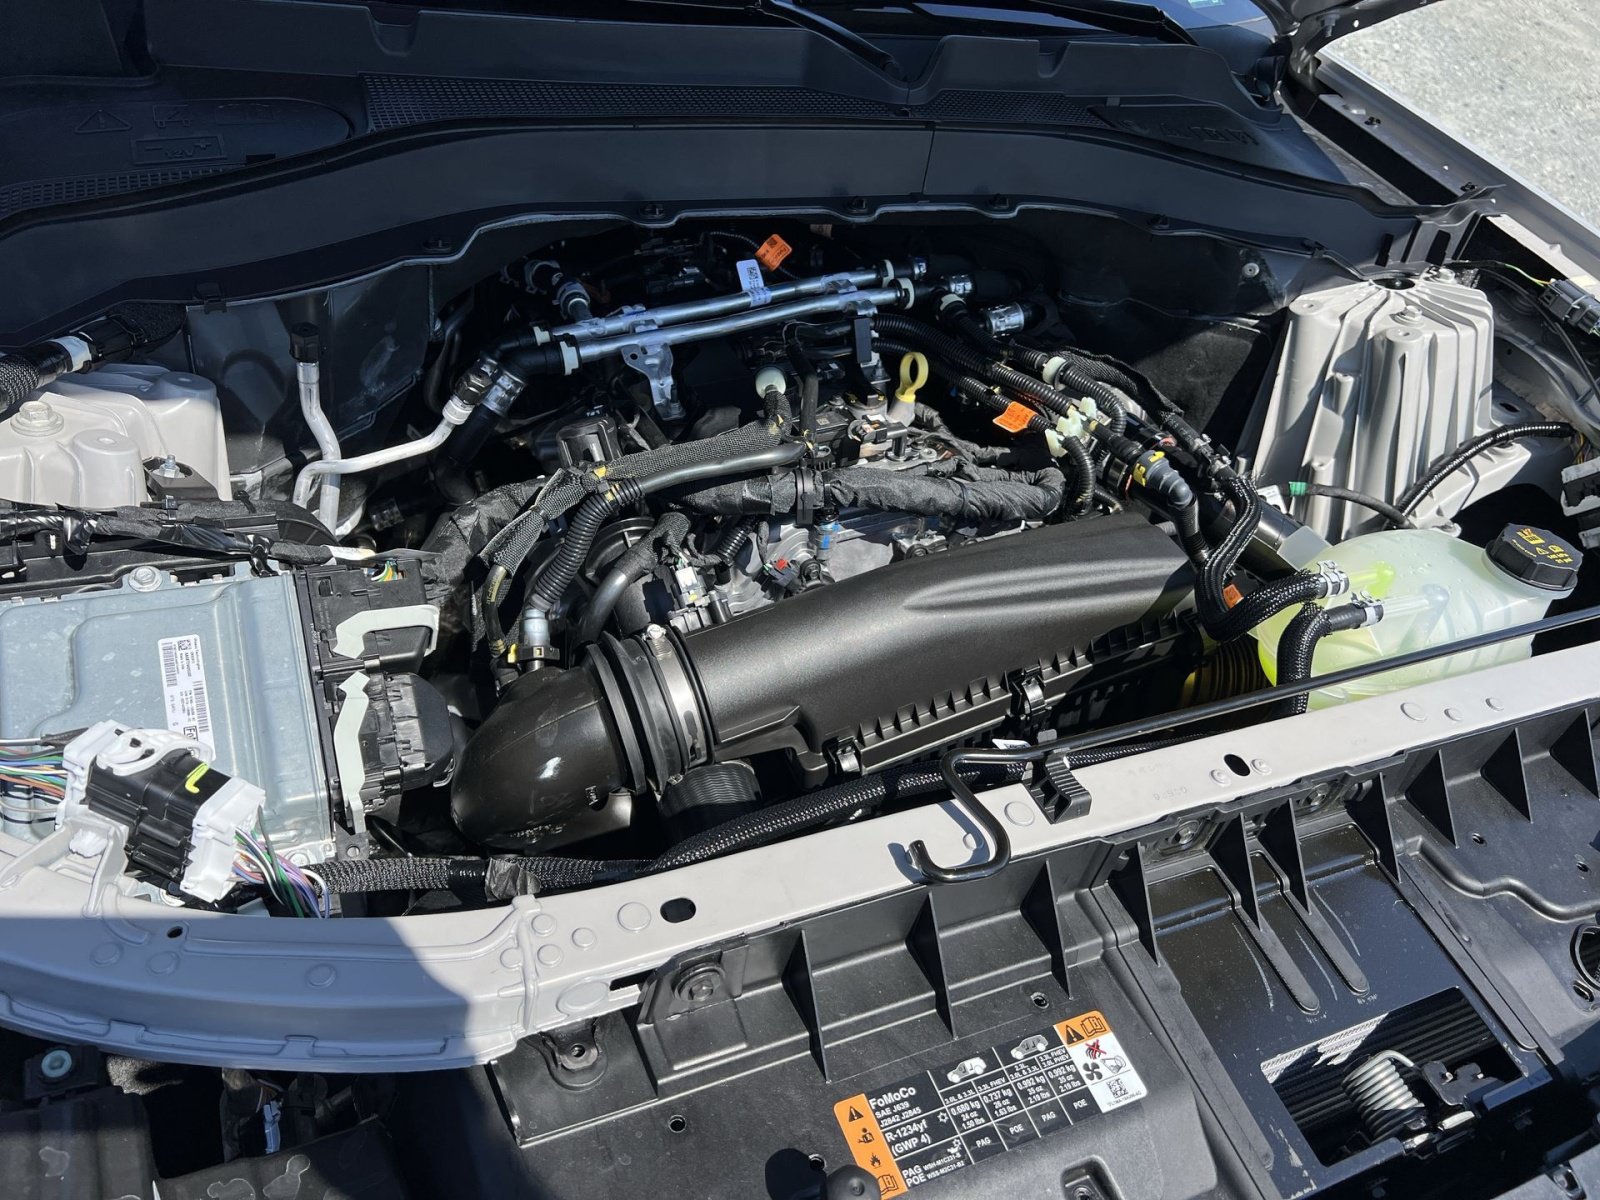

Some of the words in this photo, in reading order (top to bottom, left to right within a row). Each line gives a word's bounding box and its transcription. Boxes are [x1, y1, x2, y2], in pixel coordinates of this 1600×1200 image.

[1048, 1066, 1066, 1078] 0.992
[1065, 1064, 1076, 1072] kg
[1017, 1078, 1036, 1090] 0.992
[1059, 1083, 1071, 1092] 2.19
[983, 1090, 1001, 1103] 0.737
[1001, 1088, 1013, 1097] kg
[1027, 1087, 1035, 1095] 35
[869, 1087, 916, 1109] FoMoCo
[1028, 1094, 1041, 1104] 2.19
[1073, 1099, 1087, 1109] POE
[875, 1107, 892, 1118] SAE
[893, 1101, 909, 1112] J639
[951, 1103, 970, 1115] 0.680
[969, 1101, 981, 1109] kg
[880, 1115, 900, 1127] J2842
[902, 1107, 921, 1119] J2845
[961, 1113, 970, 1121] 24
[1041, 1112, 1056, 1121] PAG
[885, 1119, 927, 1142] R-1234yf
[1009, 1124, 1024, 1134] POE
[892, 1137, 918, 1156] (GWP
[921, 1133, 931, 1144] 4)
[976, 1137, 991, 1147] PAG
[902, 1165, 922, 1178] PAG
[906, 1173, 926, 1187] POE
